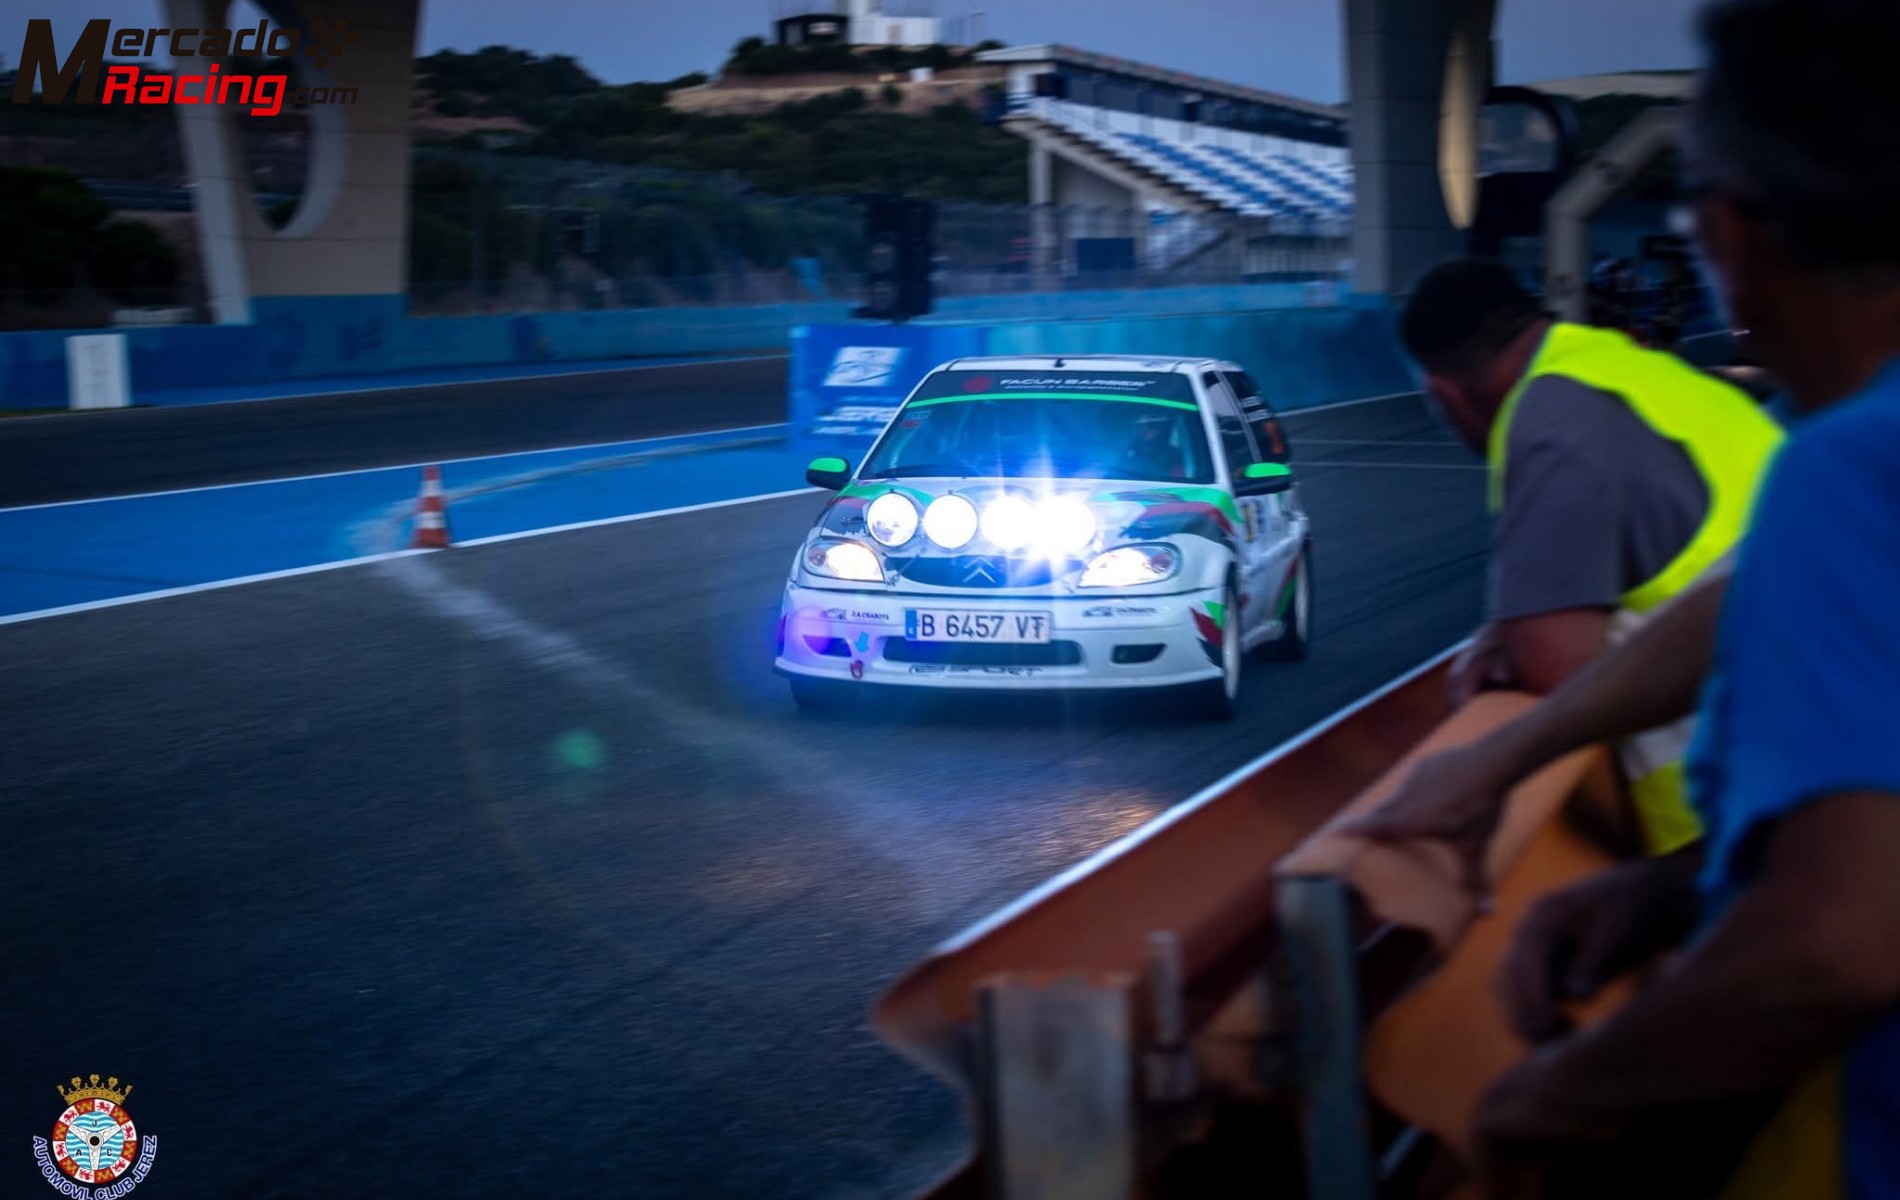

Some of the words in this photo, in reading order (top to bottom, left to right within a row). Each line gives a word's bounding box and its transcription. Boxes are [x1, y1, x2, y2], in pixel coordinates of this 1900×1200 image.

[921, 613, 936, 637] B
[945, 614, 1005, 639] 6457
[1015, 616, 1045, 640] VT
